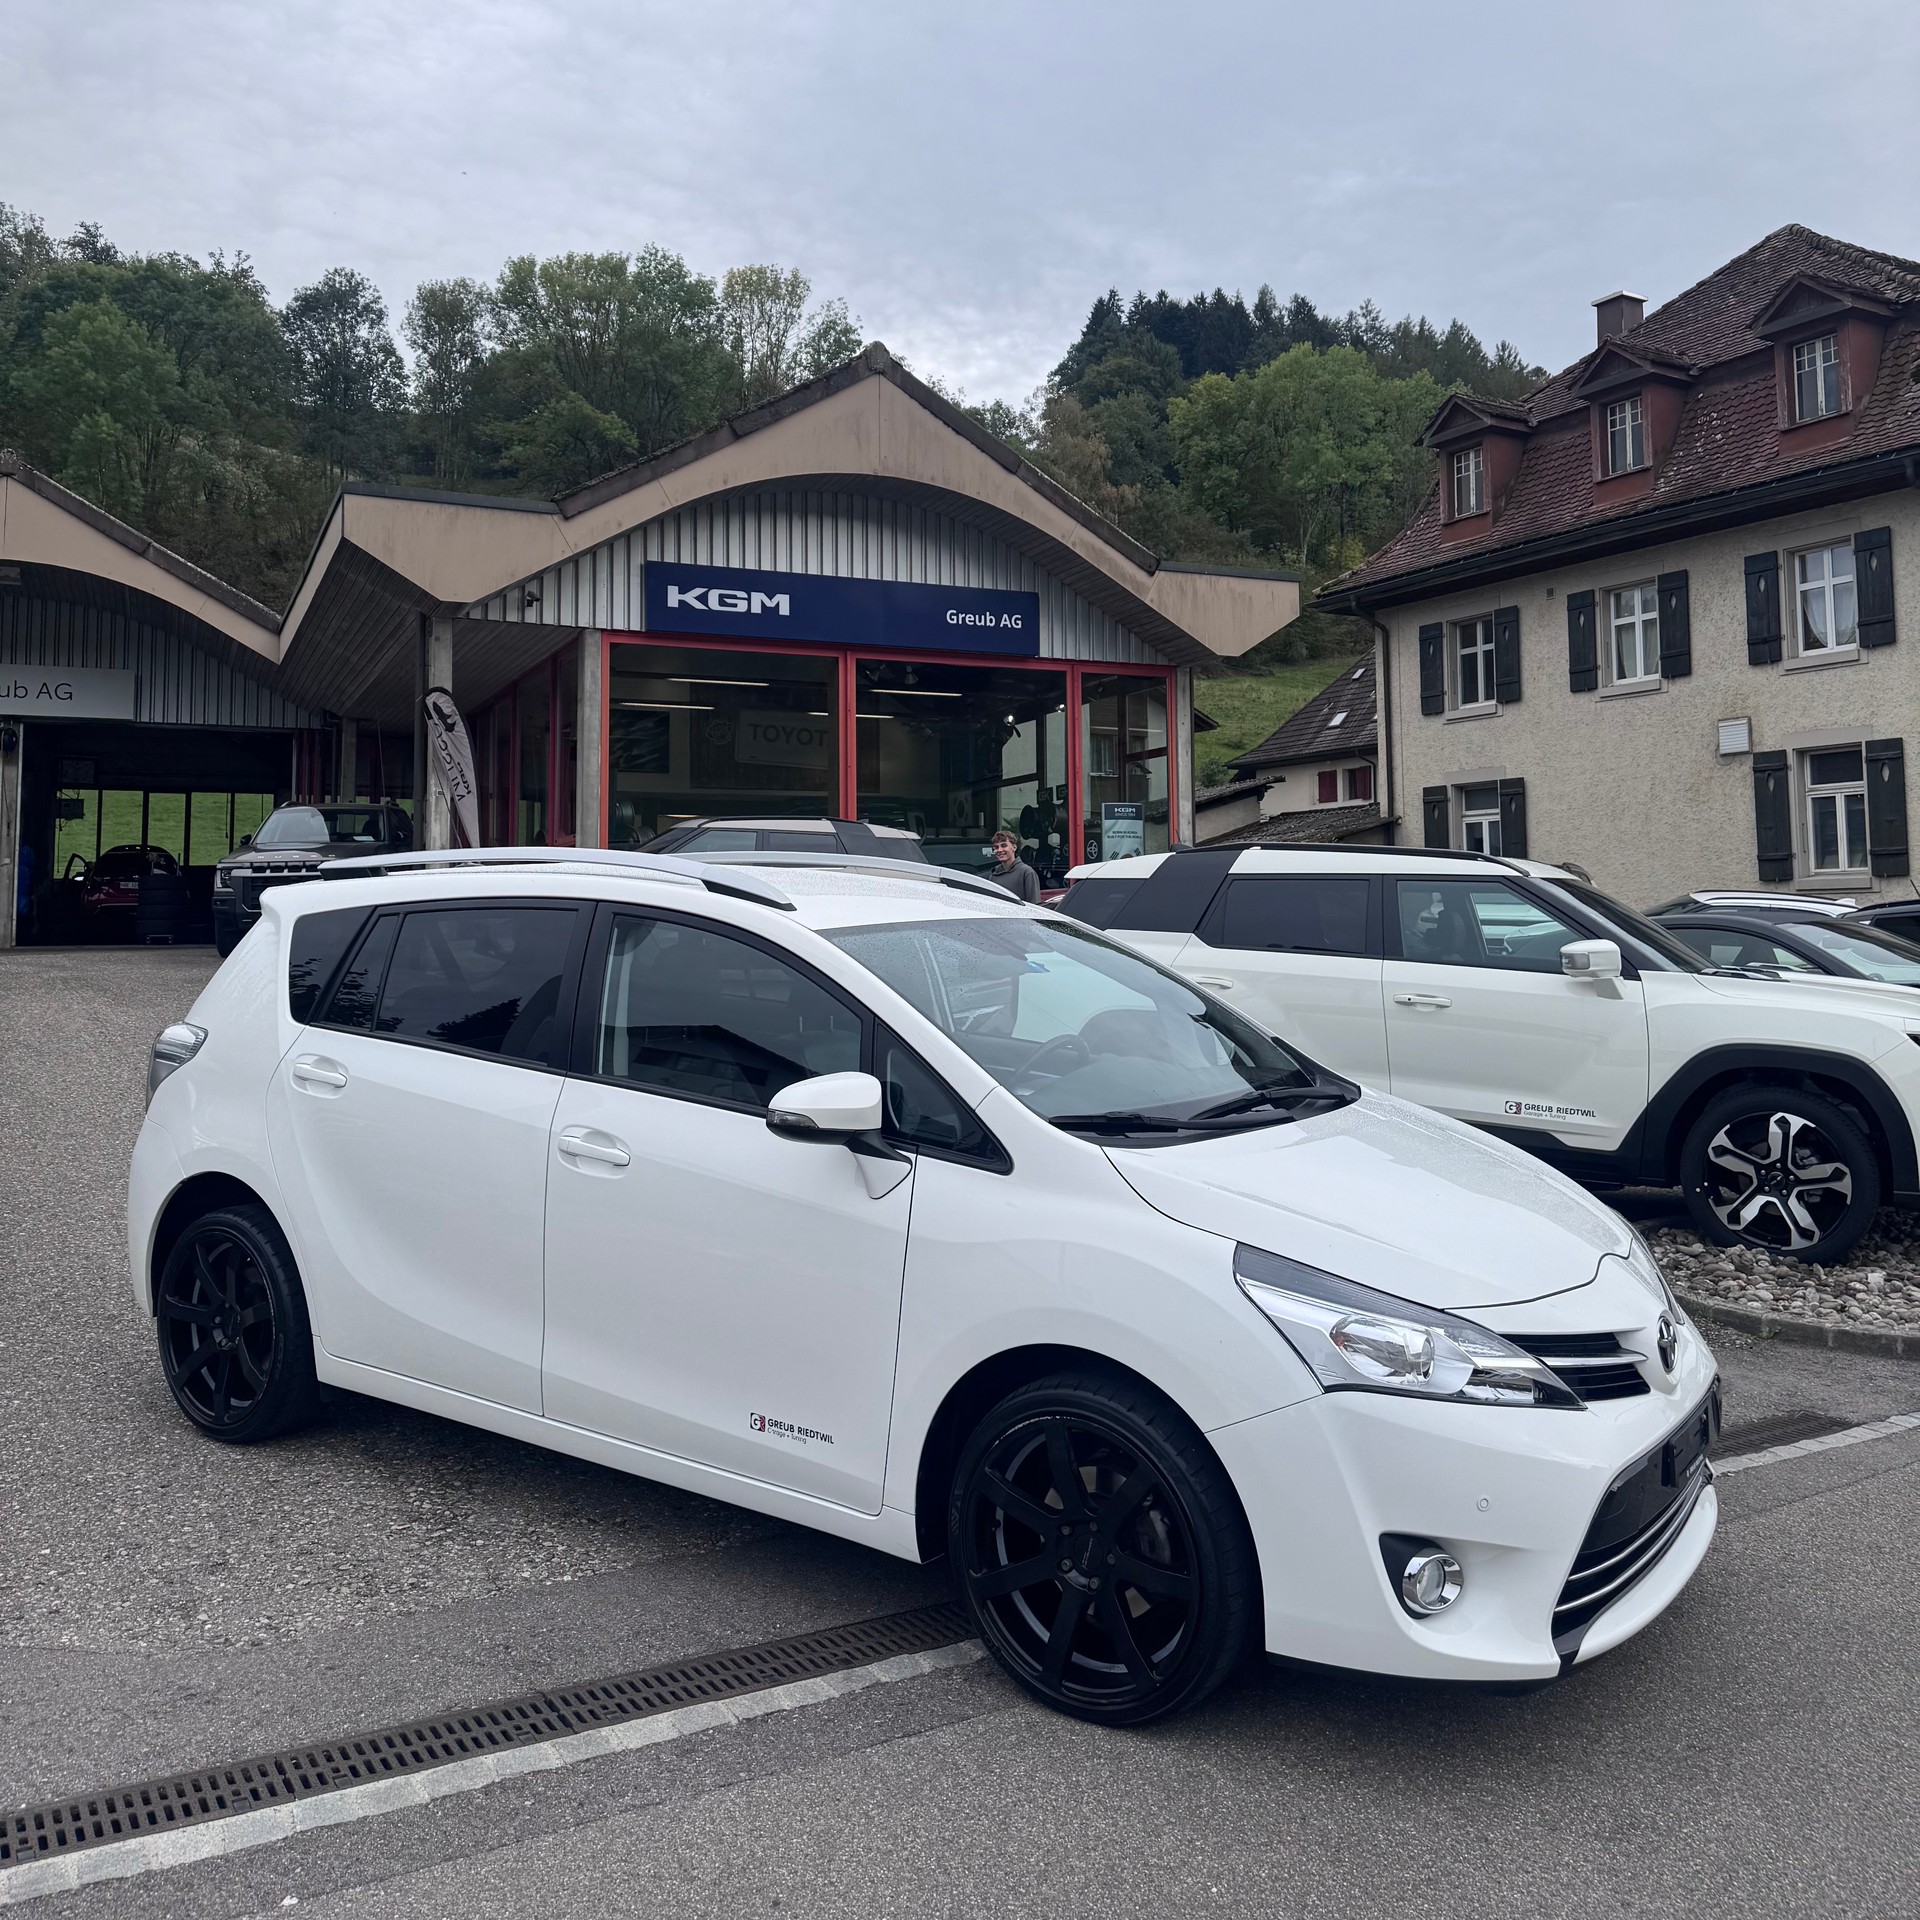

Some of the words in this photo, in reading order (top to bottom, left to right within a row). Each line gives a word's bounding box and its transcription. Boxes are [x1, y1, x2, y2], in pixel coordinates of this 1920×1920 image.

[667, 585, 790, 616] KGM
[946, 609, 996, 627] Greub
[999, 613, 1022, 629] AG
[36, 682, 73, 700] AG
[748, 723, 829, 747] TOYOT
[1524, 1103, 1553, 1113] GREUB
[1556, 1106, 1597, 1118] RIEDTWIL
[767, 1418, 795, 1433] GREUB
[797, 1426, 834, 1444] RIEDTWIL
